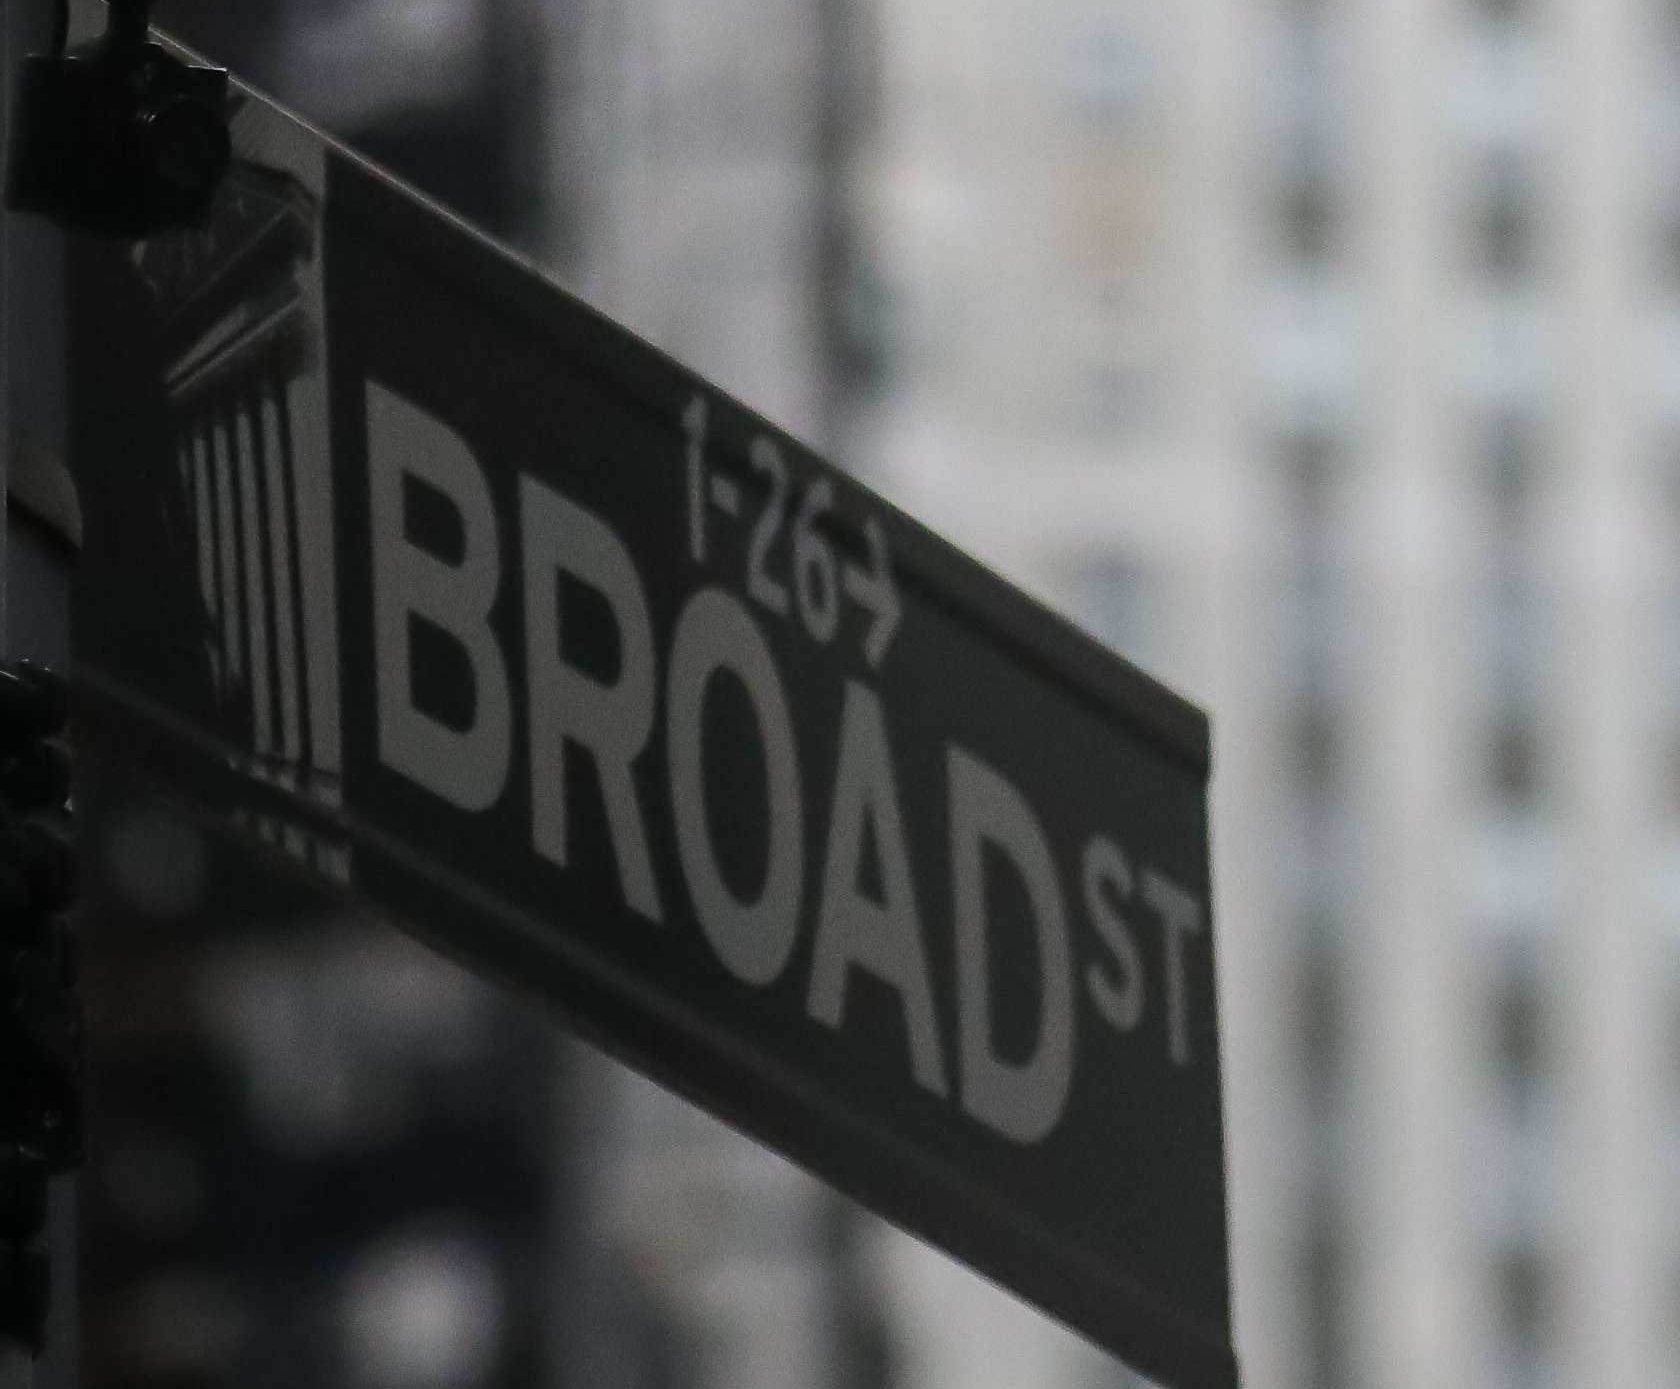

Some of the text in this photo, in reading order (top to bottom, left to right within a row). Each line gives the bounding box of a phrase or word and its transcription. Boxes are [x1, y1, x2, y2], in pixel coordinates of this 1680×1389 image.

[364, 378, 1202, 1144] BROAD ST
[681, 394, 839, 643] 1-26
